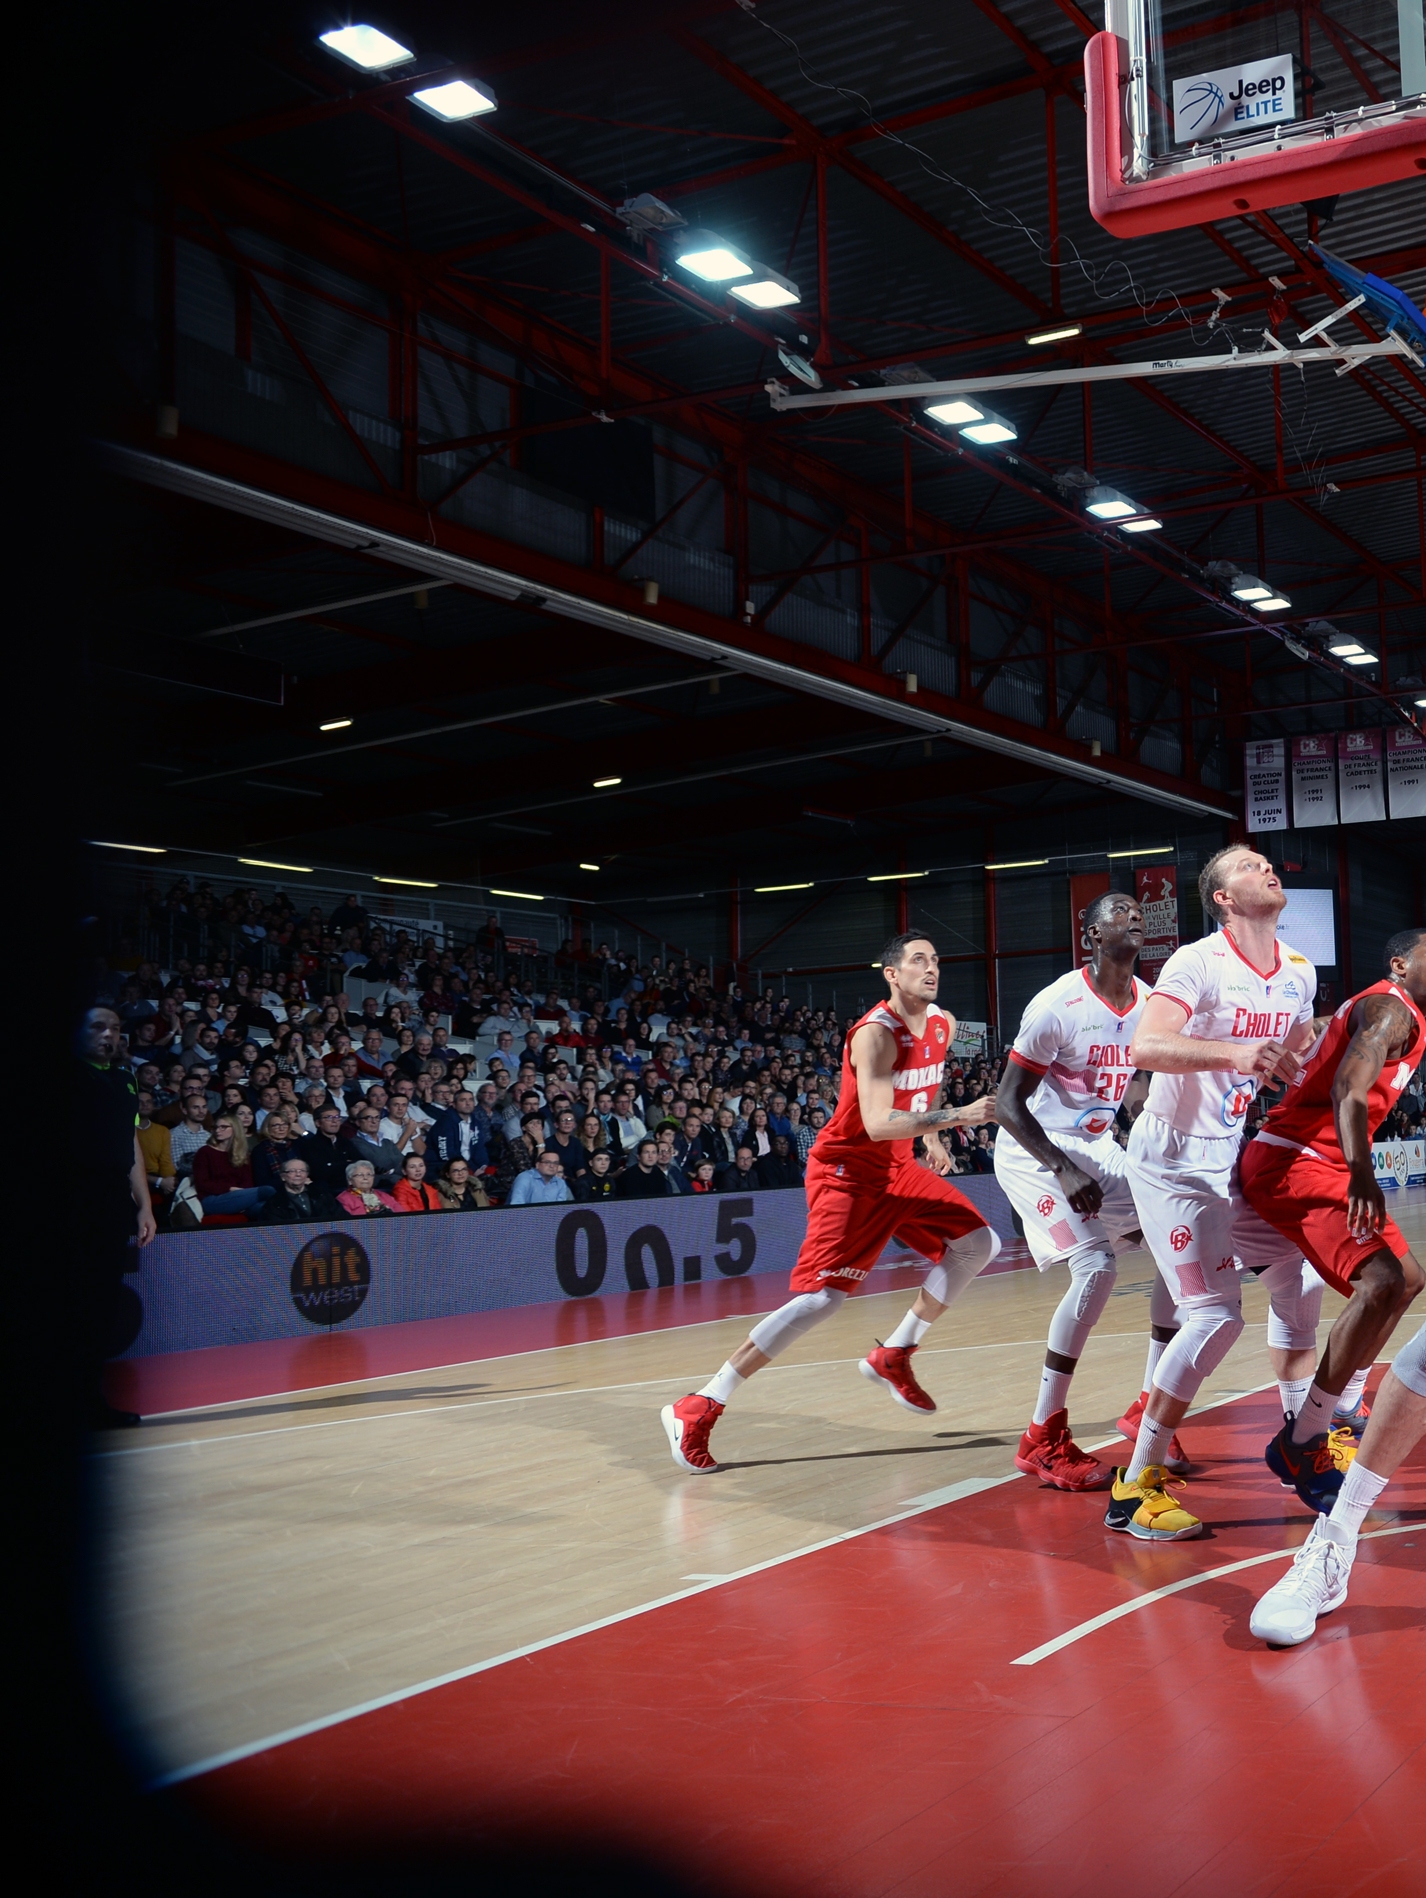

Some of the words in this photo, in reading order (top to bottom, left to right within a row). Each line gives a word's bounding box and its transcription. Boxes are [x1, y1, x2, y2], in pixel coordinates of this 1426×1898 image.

[1229, 76, 1285, 100] Jeep
[1234, 97, 1283, 121] ÉLITE
[1250, 771, 1282, 780] CRÉATION
[1144, 926, 1176, 936] SPORTIVE
[1231, 1008, 1291, 1038] CHOLET
[303, 1247, 360, 1286] hit
[299, 1286, 360, 1307] west
